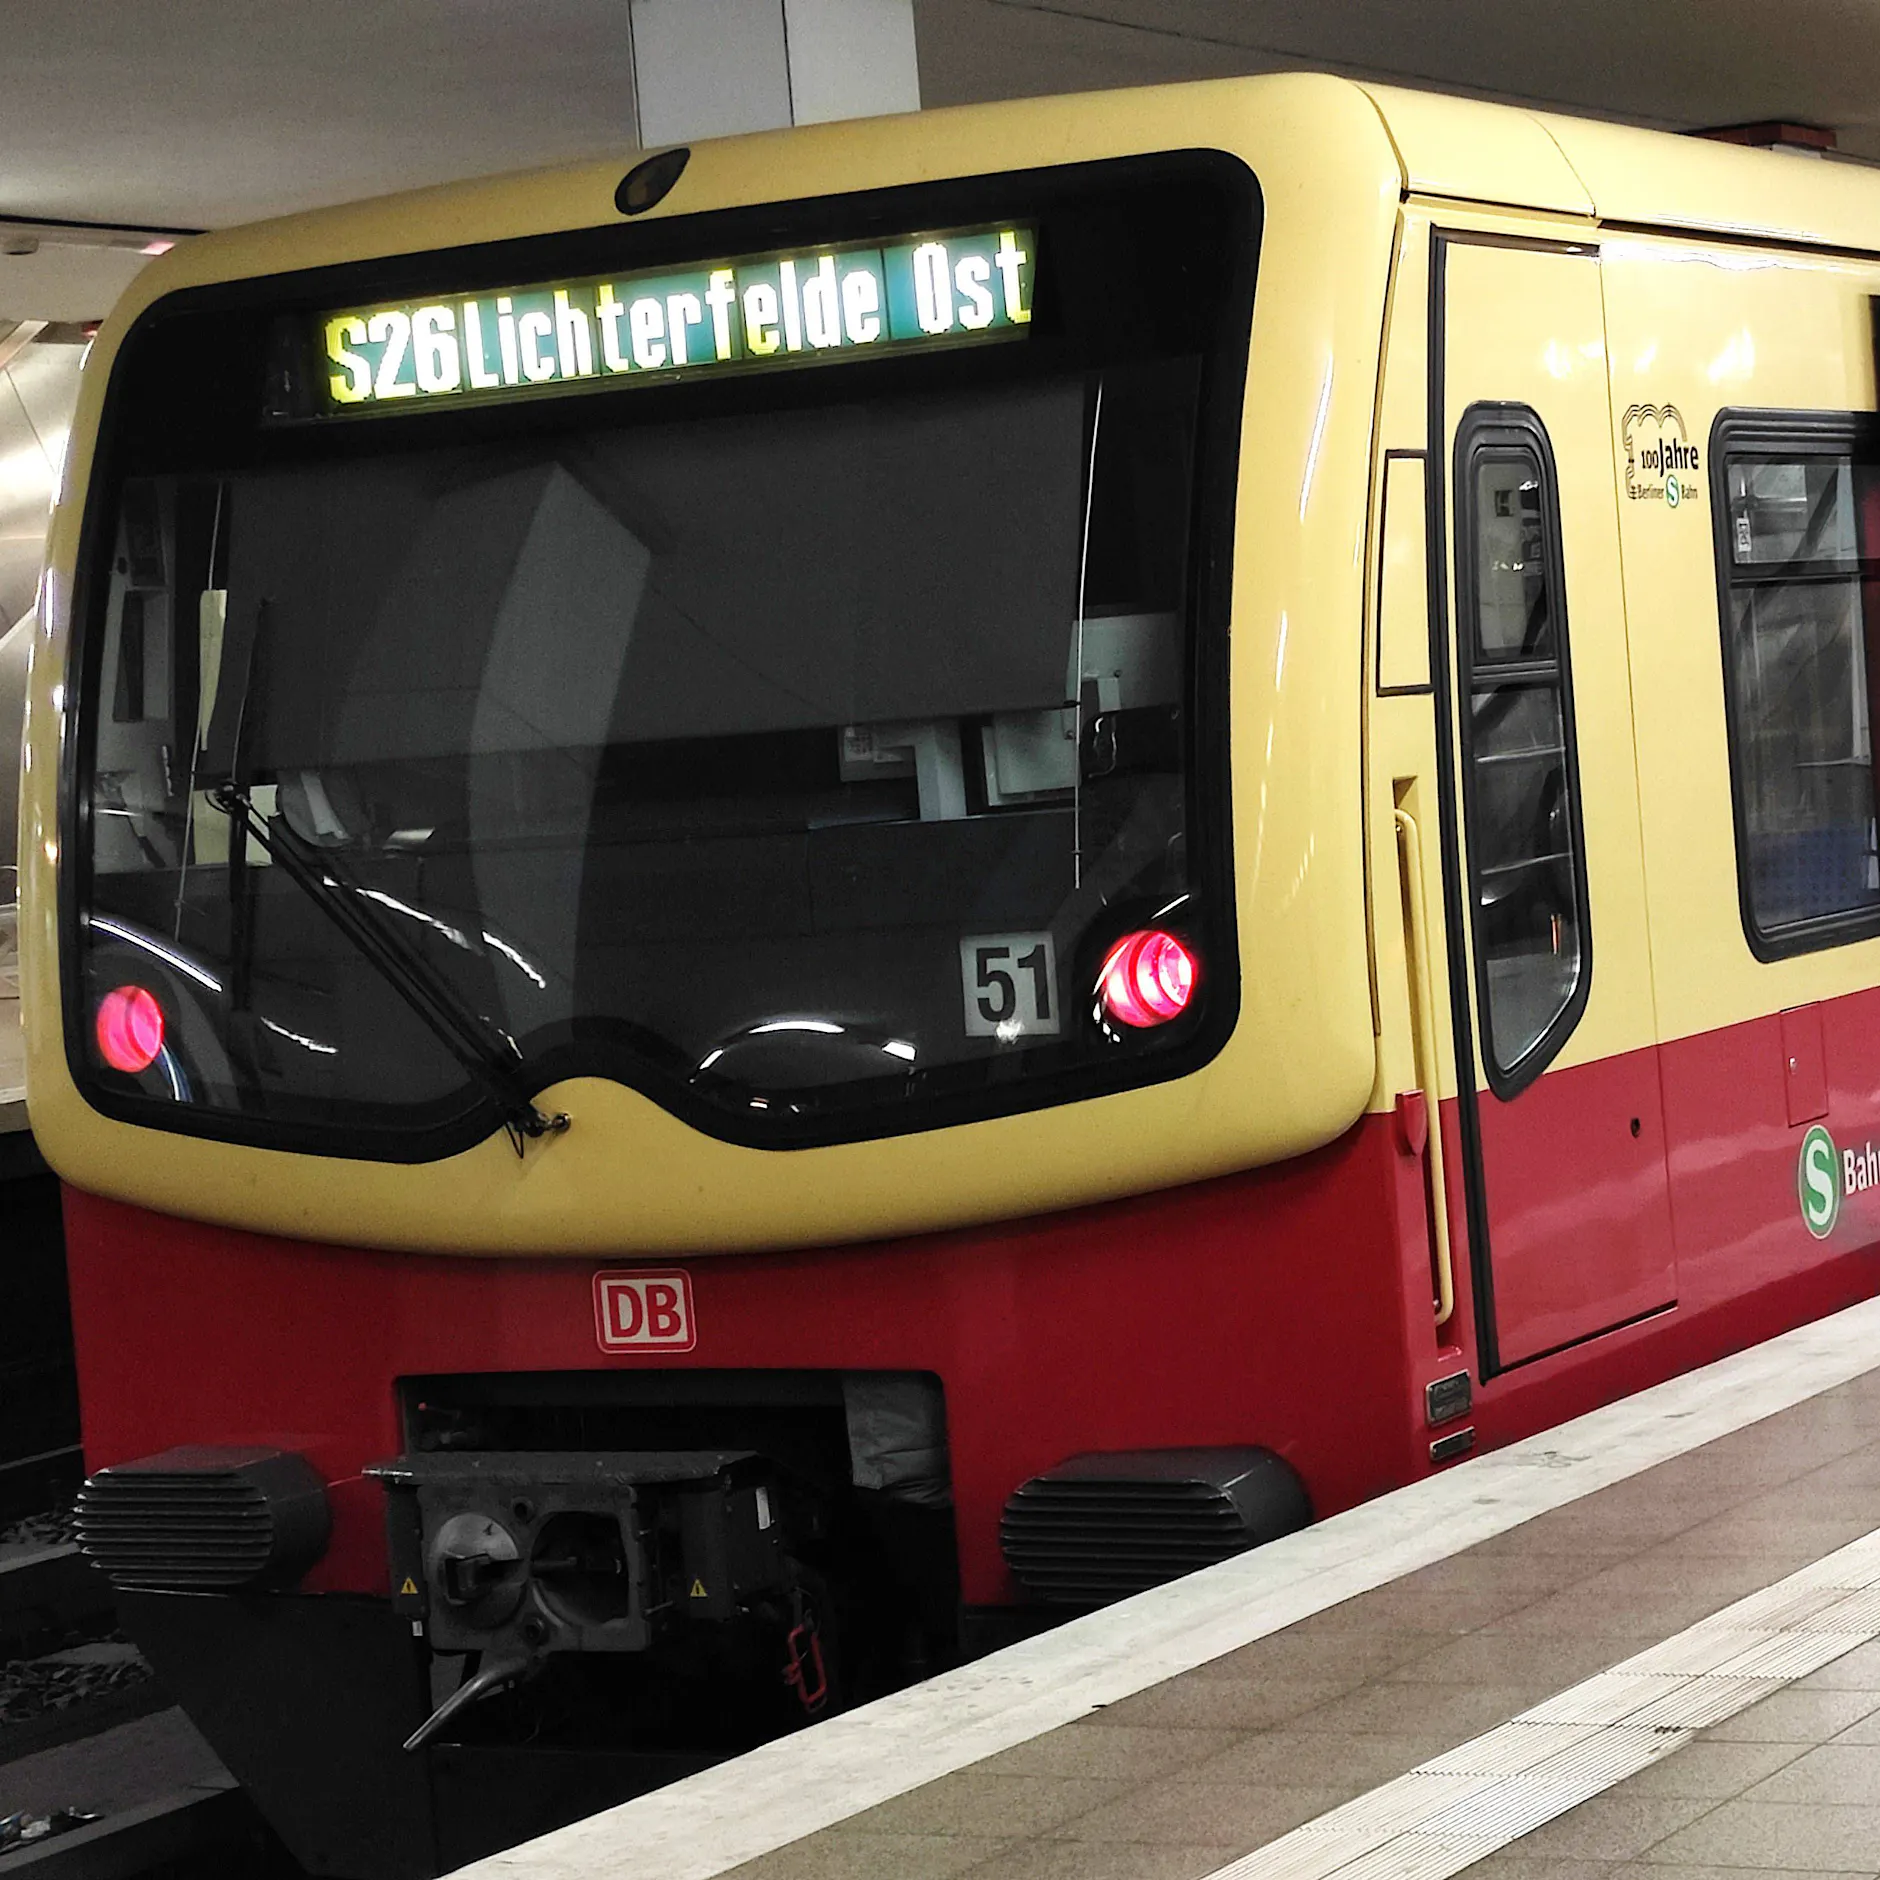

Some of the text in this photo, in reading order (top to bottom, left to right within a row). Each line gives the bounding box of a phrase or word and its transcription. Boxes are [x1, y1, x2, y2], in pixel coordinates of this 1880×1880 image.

[324, 230, 1032, 404] S26 Lichterfelde Ost
[976, 944, 1050, 1022] 51
[1806, 1139, 1880, 1226] S Bah
[606, 1284, 682, 1338] DB
